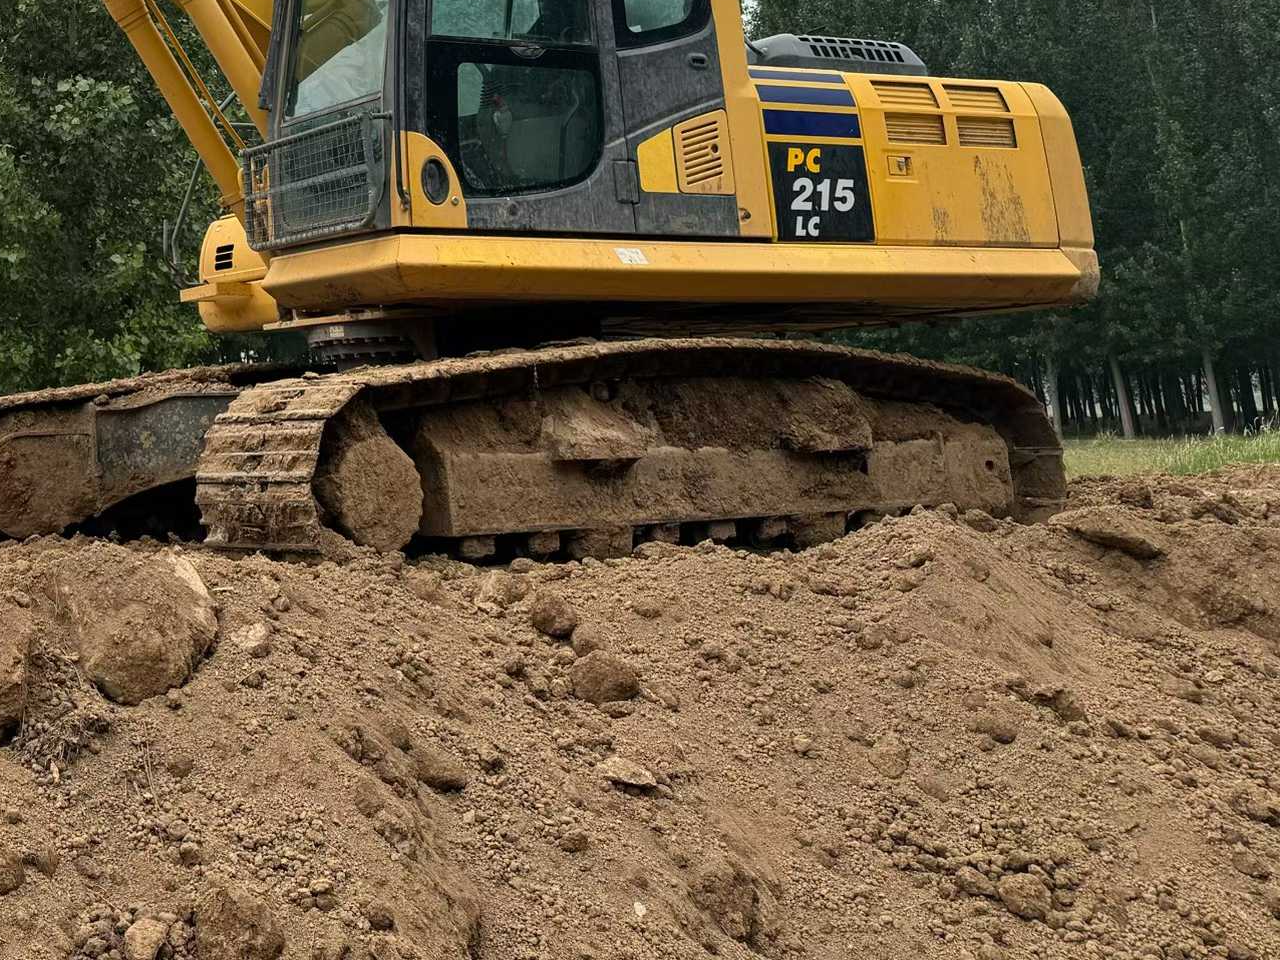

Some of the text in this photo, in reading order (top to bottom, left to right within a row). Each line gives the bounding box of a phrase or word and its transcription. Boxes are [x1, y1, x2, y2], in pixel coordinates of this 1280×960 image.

[787, 147, 821, 173] PC
[790, 177, 855, 212] 215
[795, 215, 820, 237] LC
